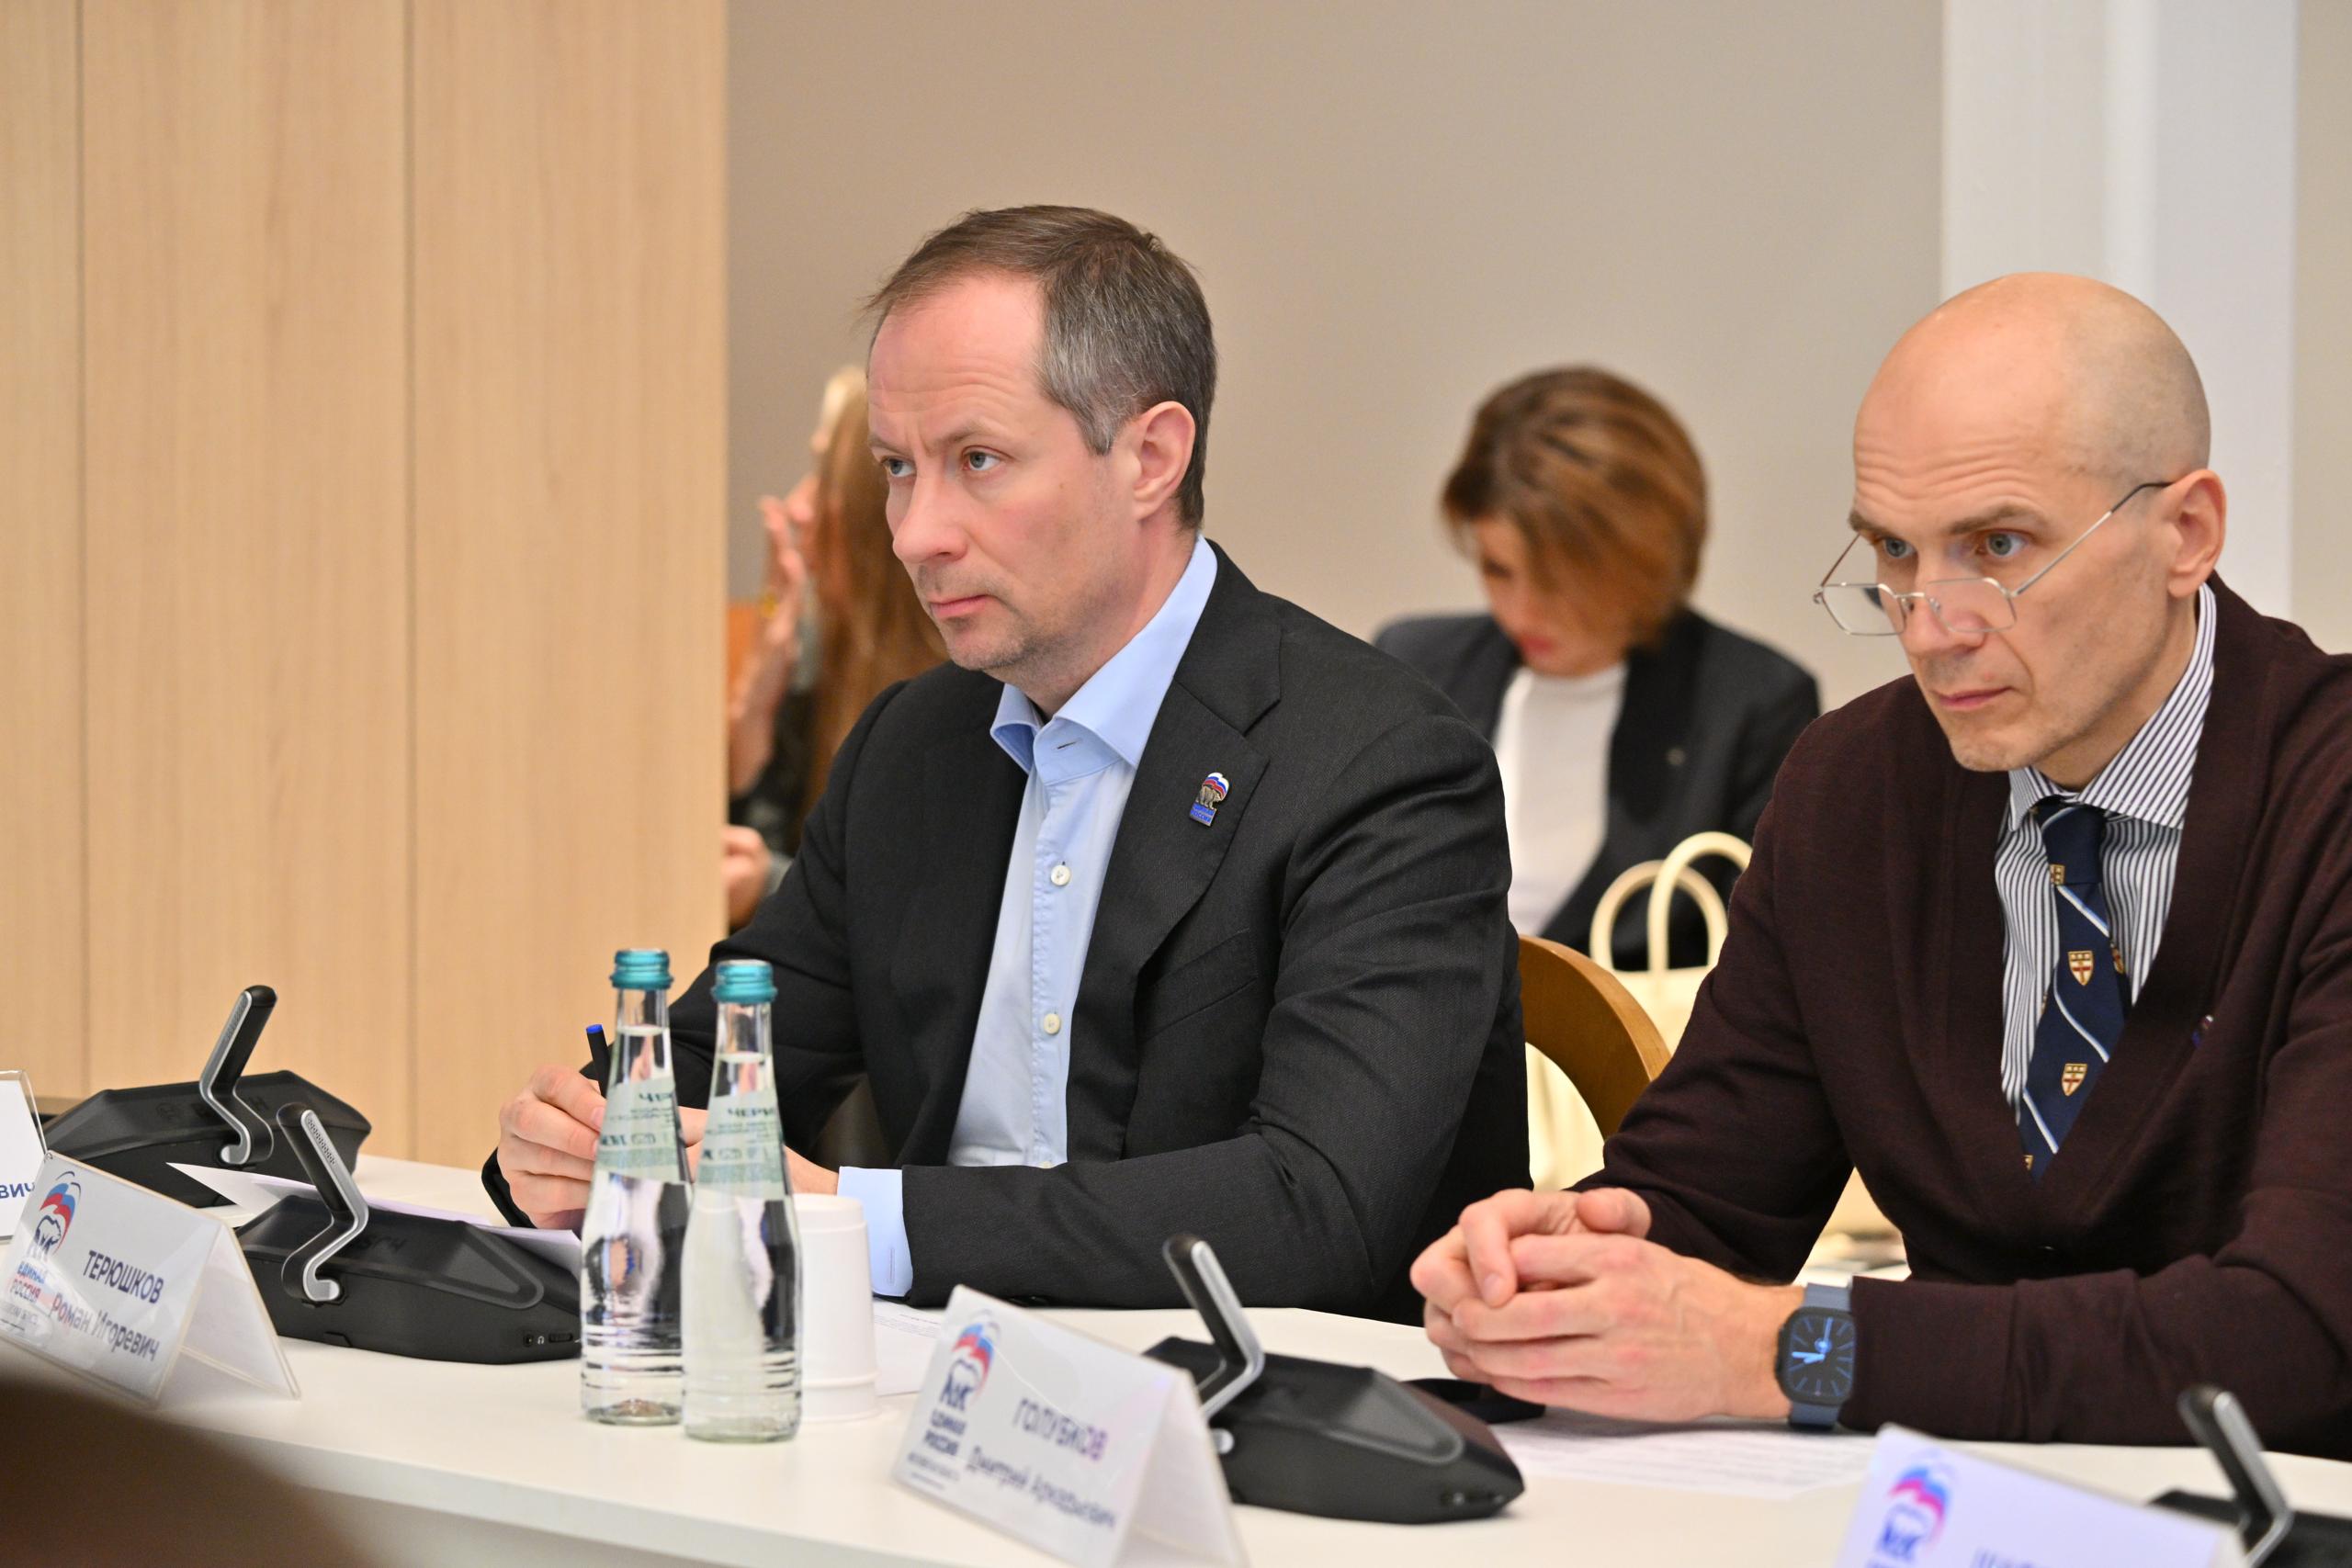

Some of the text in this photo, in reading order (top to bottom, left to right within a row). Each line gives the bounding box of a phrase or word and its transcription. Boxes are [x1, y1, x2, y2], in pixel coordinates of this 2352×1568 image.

[84, 1250, 164, 1303] ТЕРЮШКОВ
[49, 1292, 92, 1333] Роман
[91, 1309, 161, 1360] Игоревич
